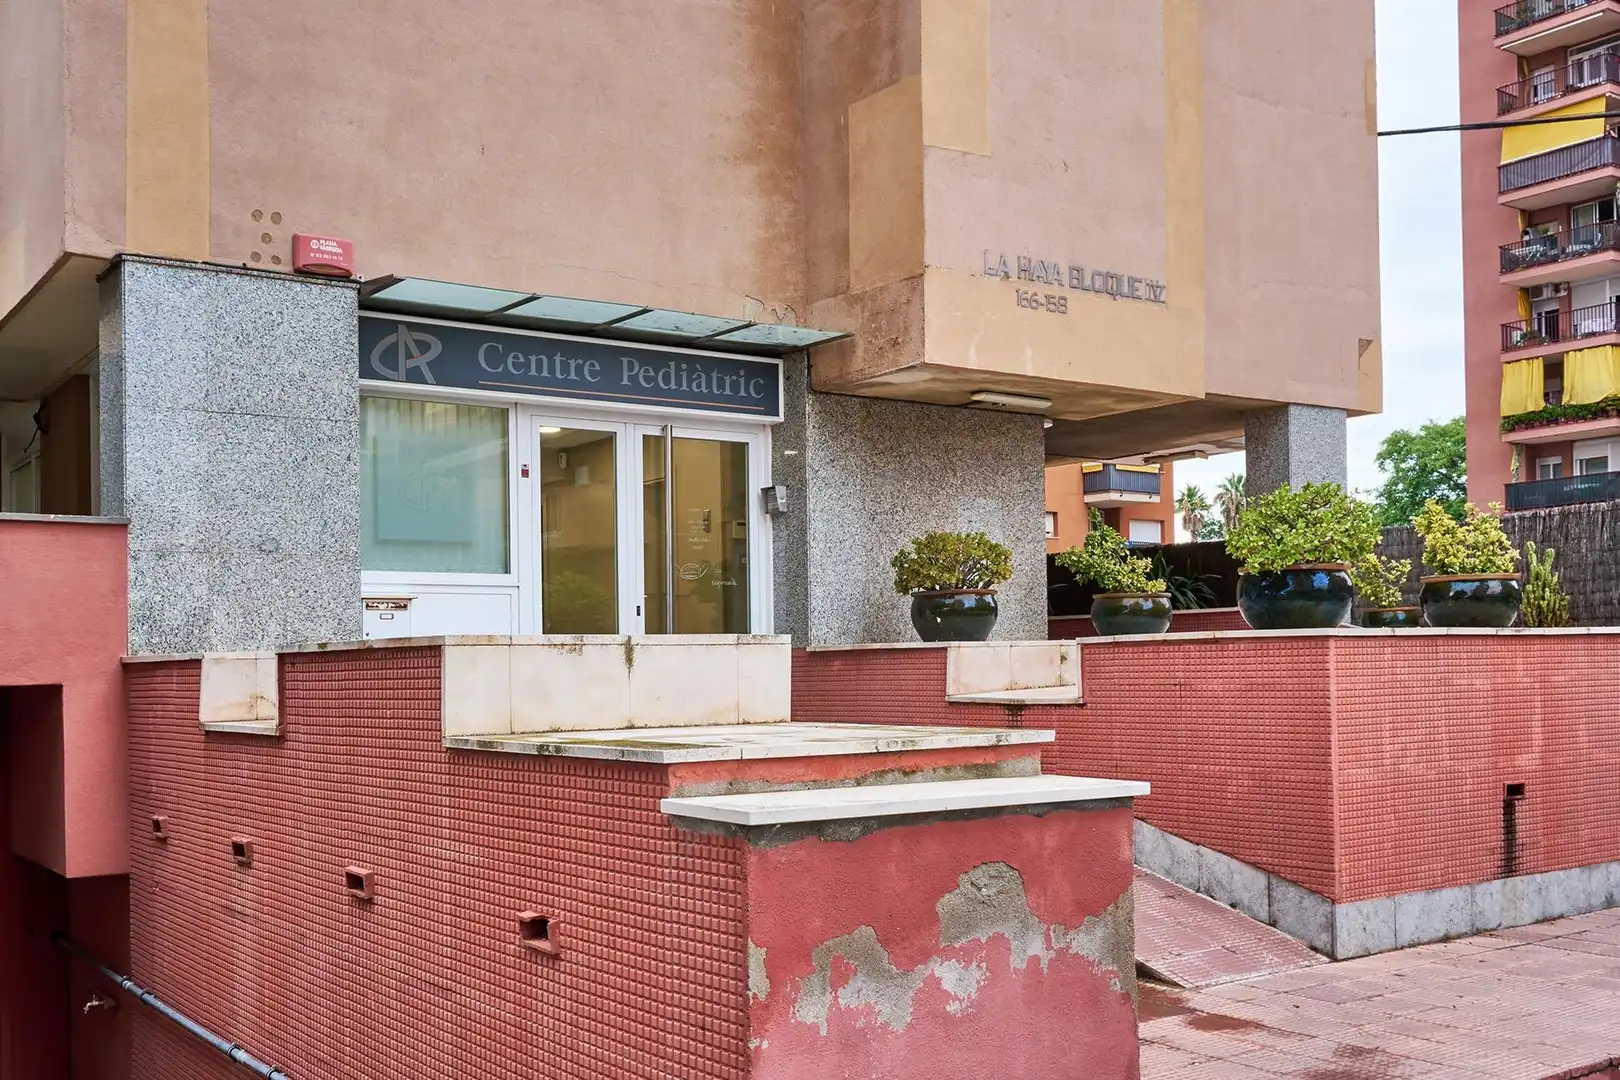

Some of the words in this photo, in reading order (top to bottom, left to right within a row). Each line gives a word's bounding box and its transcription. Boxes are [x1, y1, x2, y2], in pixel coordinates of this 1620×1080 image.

[983, 249, 1011, 280] LA
[1068, 264, 1143, 301] BLOQUE
[477, 341, 601, 384] Centre
[619, 356, 765, 399] Pediàtric
